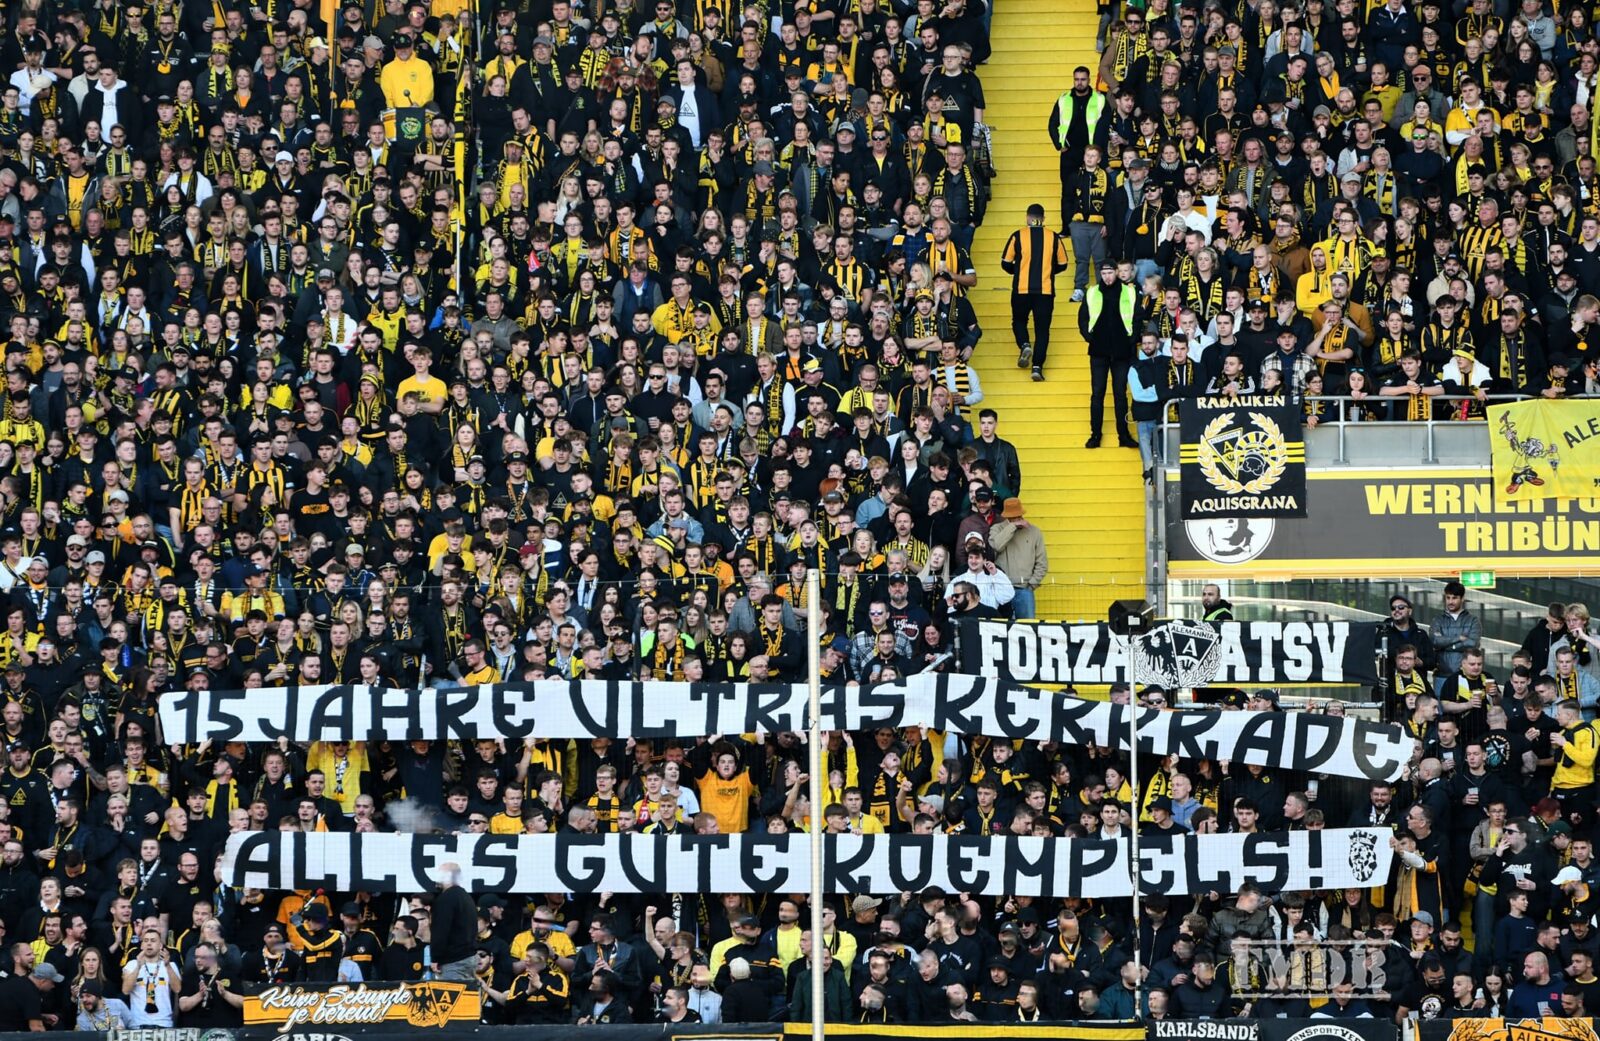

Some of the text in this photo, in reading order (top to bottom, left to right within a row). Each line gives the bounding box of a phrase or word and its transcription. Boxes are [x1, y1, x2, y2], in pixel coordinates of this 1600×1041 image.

[1190, 495, 1298, 514] AQUISGRANA
[1364, 483, 1544, 515] WERN
[1171, 625, 1215, 640] ALEMANNIA
[978, 621, 1350, 683] FORZA ATSV
[1182, 638, 1198, 657] A
[174, 672, 1402, 781] 15 JAHRE ULTRAS KERKRADE
[233, 831, 518, 893] ALLES
[556, 832, 789, 893] GUTE
[259, 983, 412, 1009] Keine Sekunde
[277, 1007, 310, 1033] je
[1155, 1020, 1259, 1041] KARLSBANDE
